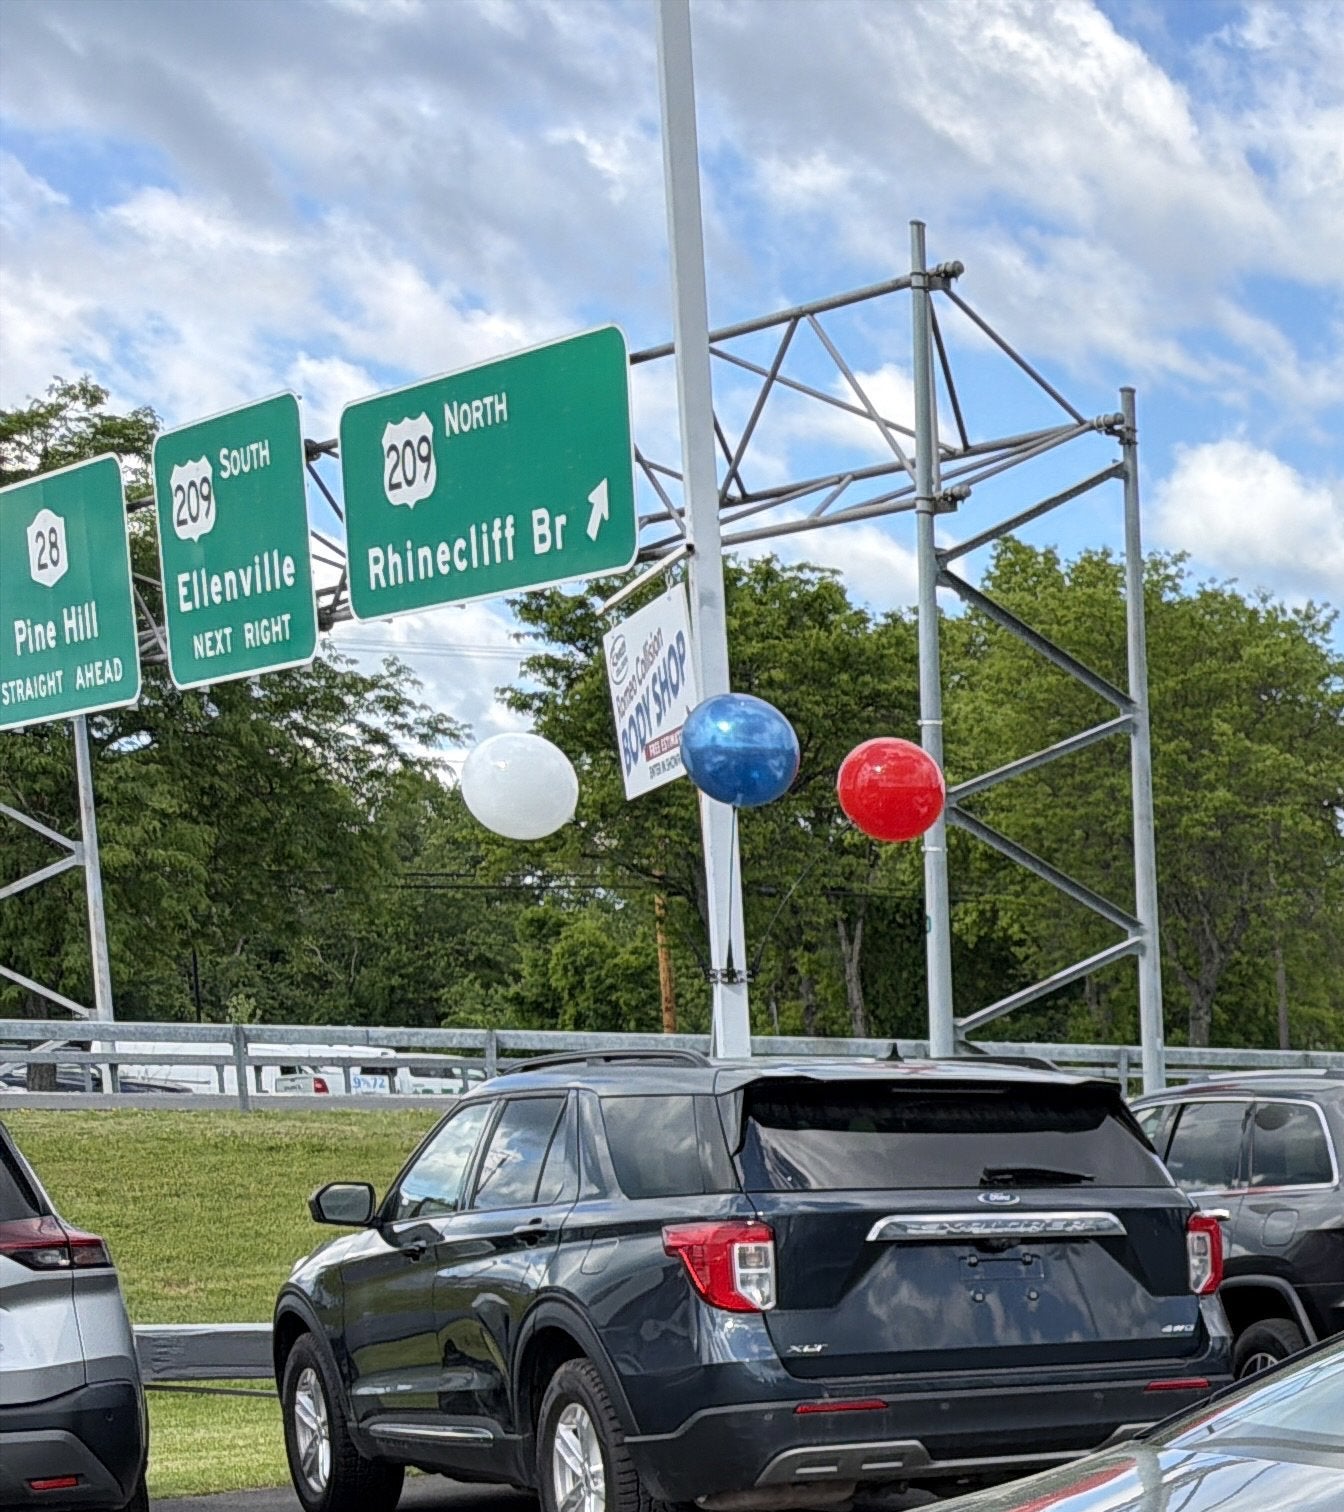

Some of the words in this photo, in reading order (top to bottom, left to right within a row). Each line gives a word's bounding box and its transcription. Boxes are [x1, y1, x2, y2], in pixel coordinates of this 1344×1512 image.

[443, 391, 508, 437] NORTH
[219, 439, 271, 479] SOUTH
[386, 434, 432, 492] 209
[174, 475, 213, 528] 209
[35, 526, 61, 571] 28
[367, 514, 515, 591] Rhinecliff
[531, 507, 567, 555] Br
[177, 548, 296, 613] Ellenville
[14, 618, 57, 656] Pine
[62, 600, 99, 645] Hill
[192, 626, 233, 660] NEXT
[244, 613, 292, 649] RIGHT
[0, 670, 63, 706] STRAIGHT
[75, 657, 123, 691] AHEAD
[621, 683, 653, 777] BODY
[651, 630, 686, 727] SHOP
